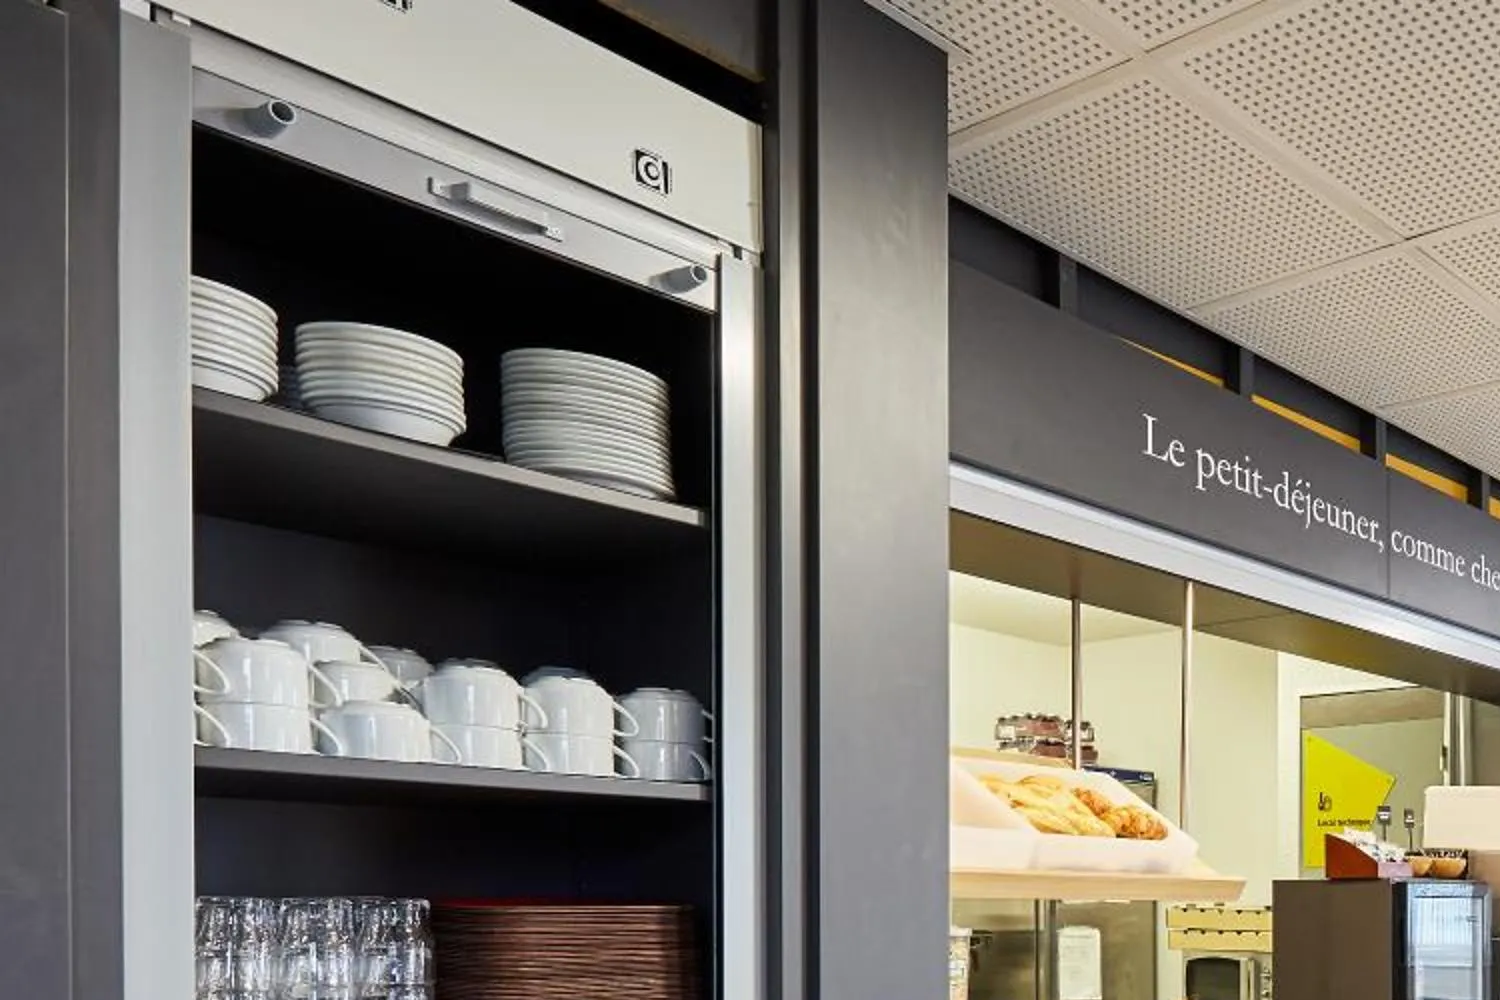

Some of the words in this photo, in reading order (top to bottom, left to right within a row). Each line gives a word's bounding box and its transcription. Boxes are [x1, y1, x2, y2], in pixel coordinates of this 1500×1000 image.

[1142, 413, 1186, 467] Le
[1195, 448, 1385, 553] petit-déjeuner,
[1391, 529, 1466, 577] comme
